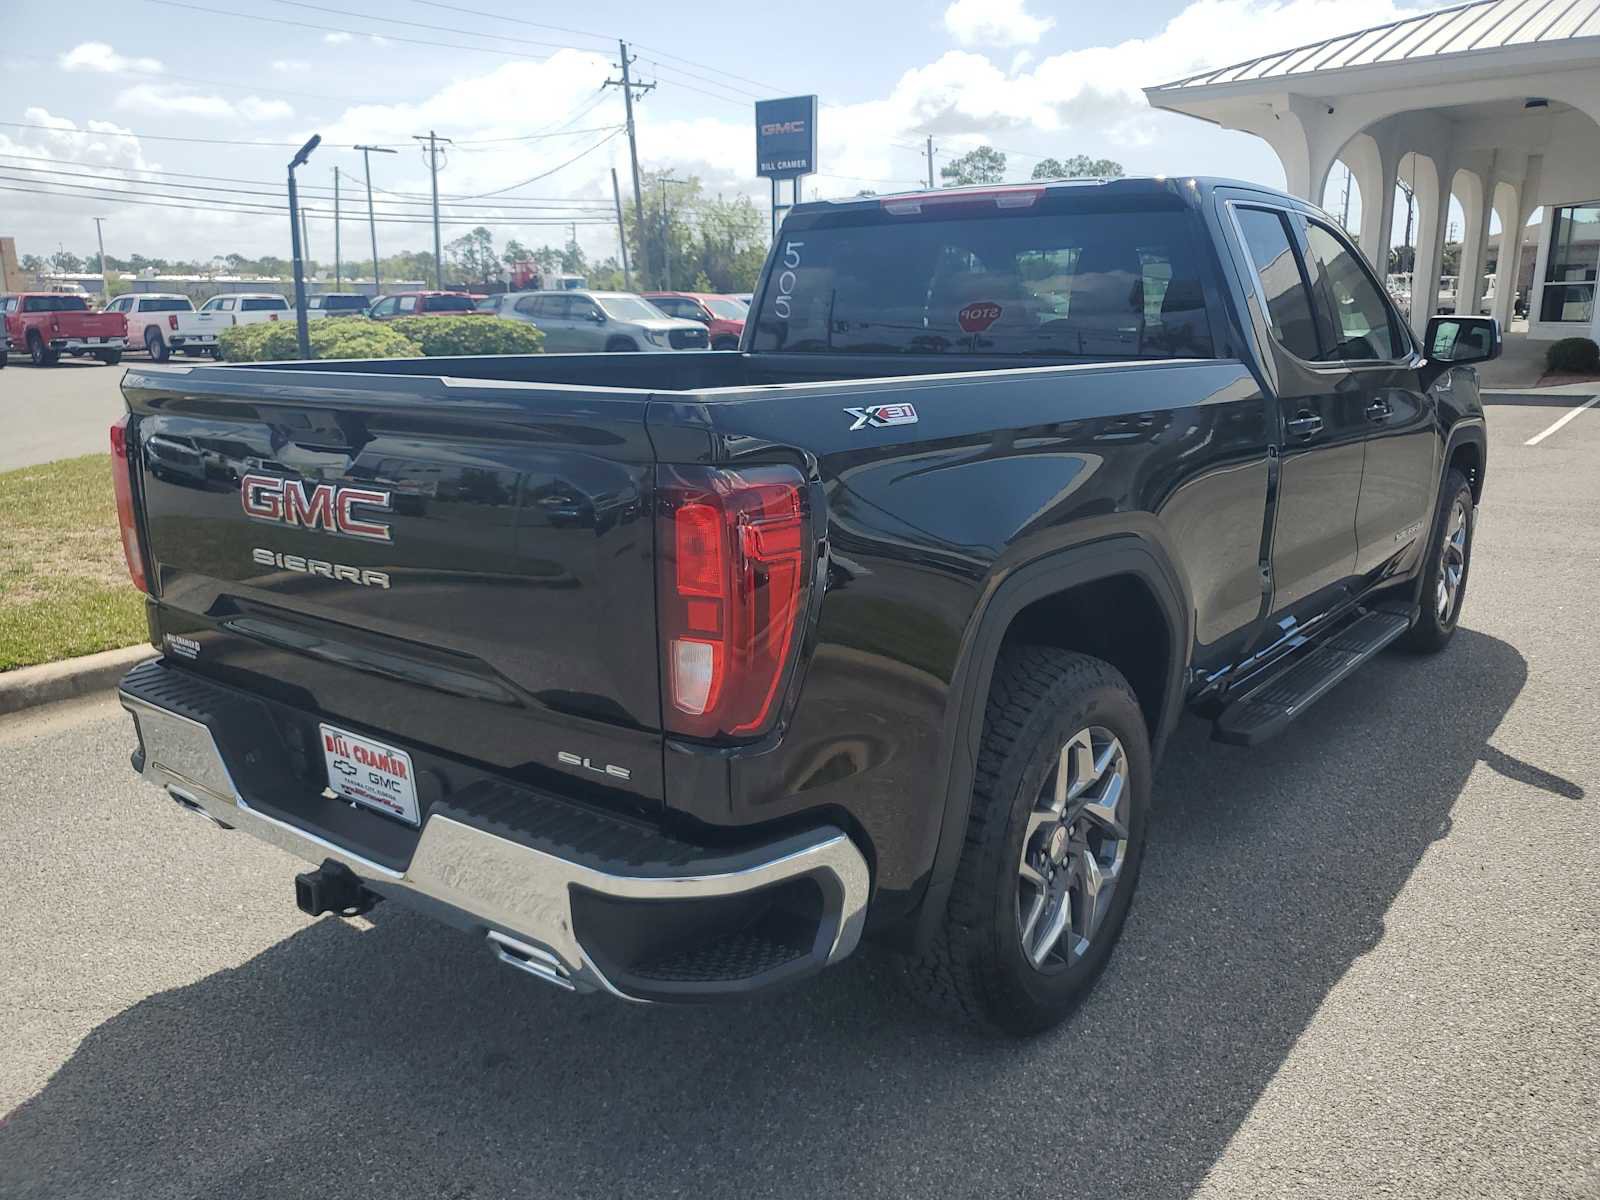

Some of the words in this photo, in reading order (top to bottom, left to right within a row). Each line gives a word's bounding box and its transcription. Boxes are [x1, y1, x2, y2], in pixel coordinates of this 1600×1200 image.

[761, 121, 805, 136] GMC
[761, 161, 776, 171] BILL
[777, 160, 807, 170] CRAMER
[775, 241, 804, 319] 505
[843, 403, 918, 431] X31
[241, 474, 391, 541] GMC
[252, 548, 391, 589] SIERRA
[325, 735, 350, 759] BILL
[353, 745, 407, 780] CRAMER
[558, 751, 631, 779] SLE
[369, 772, 402, 793] GMC
